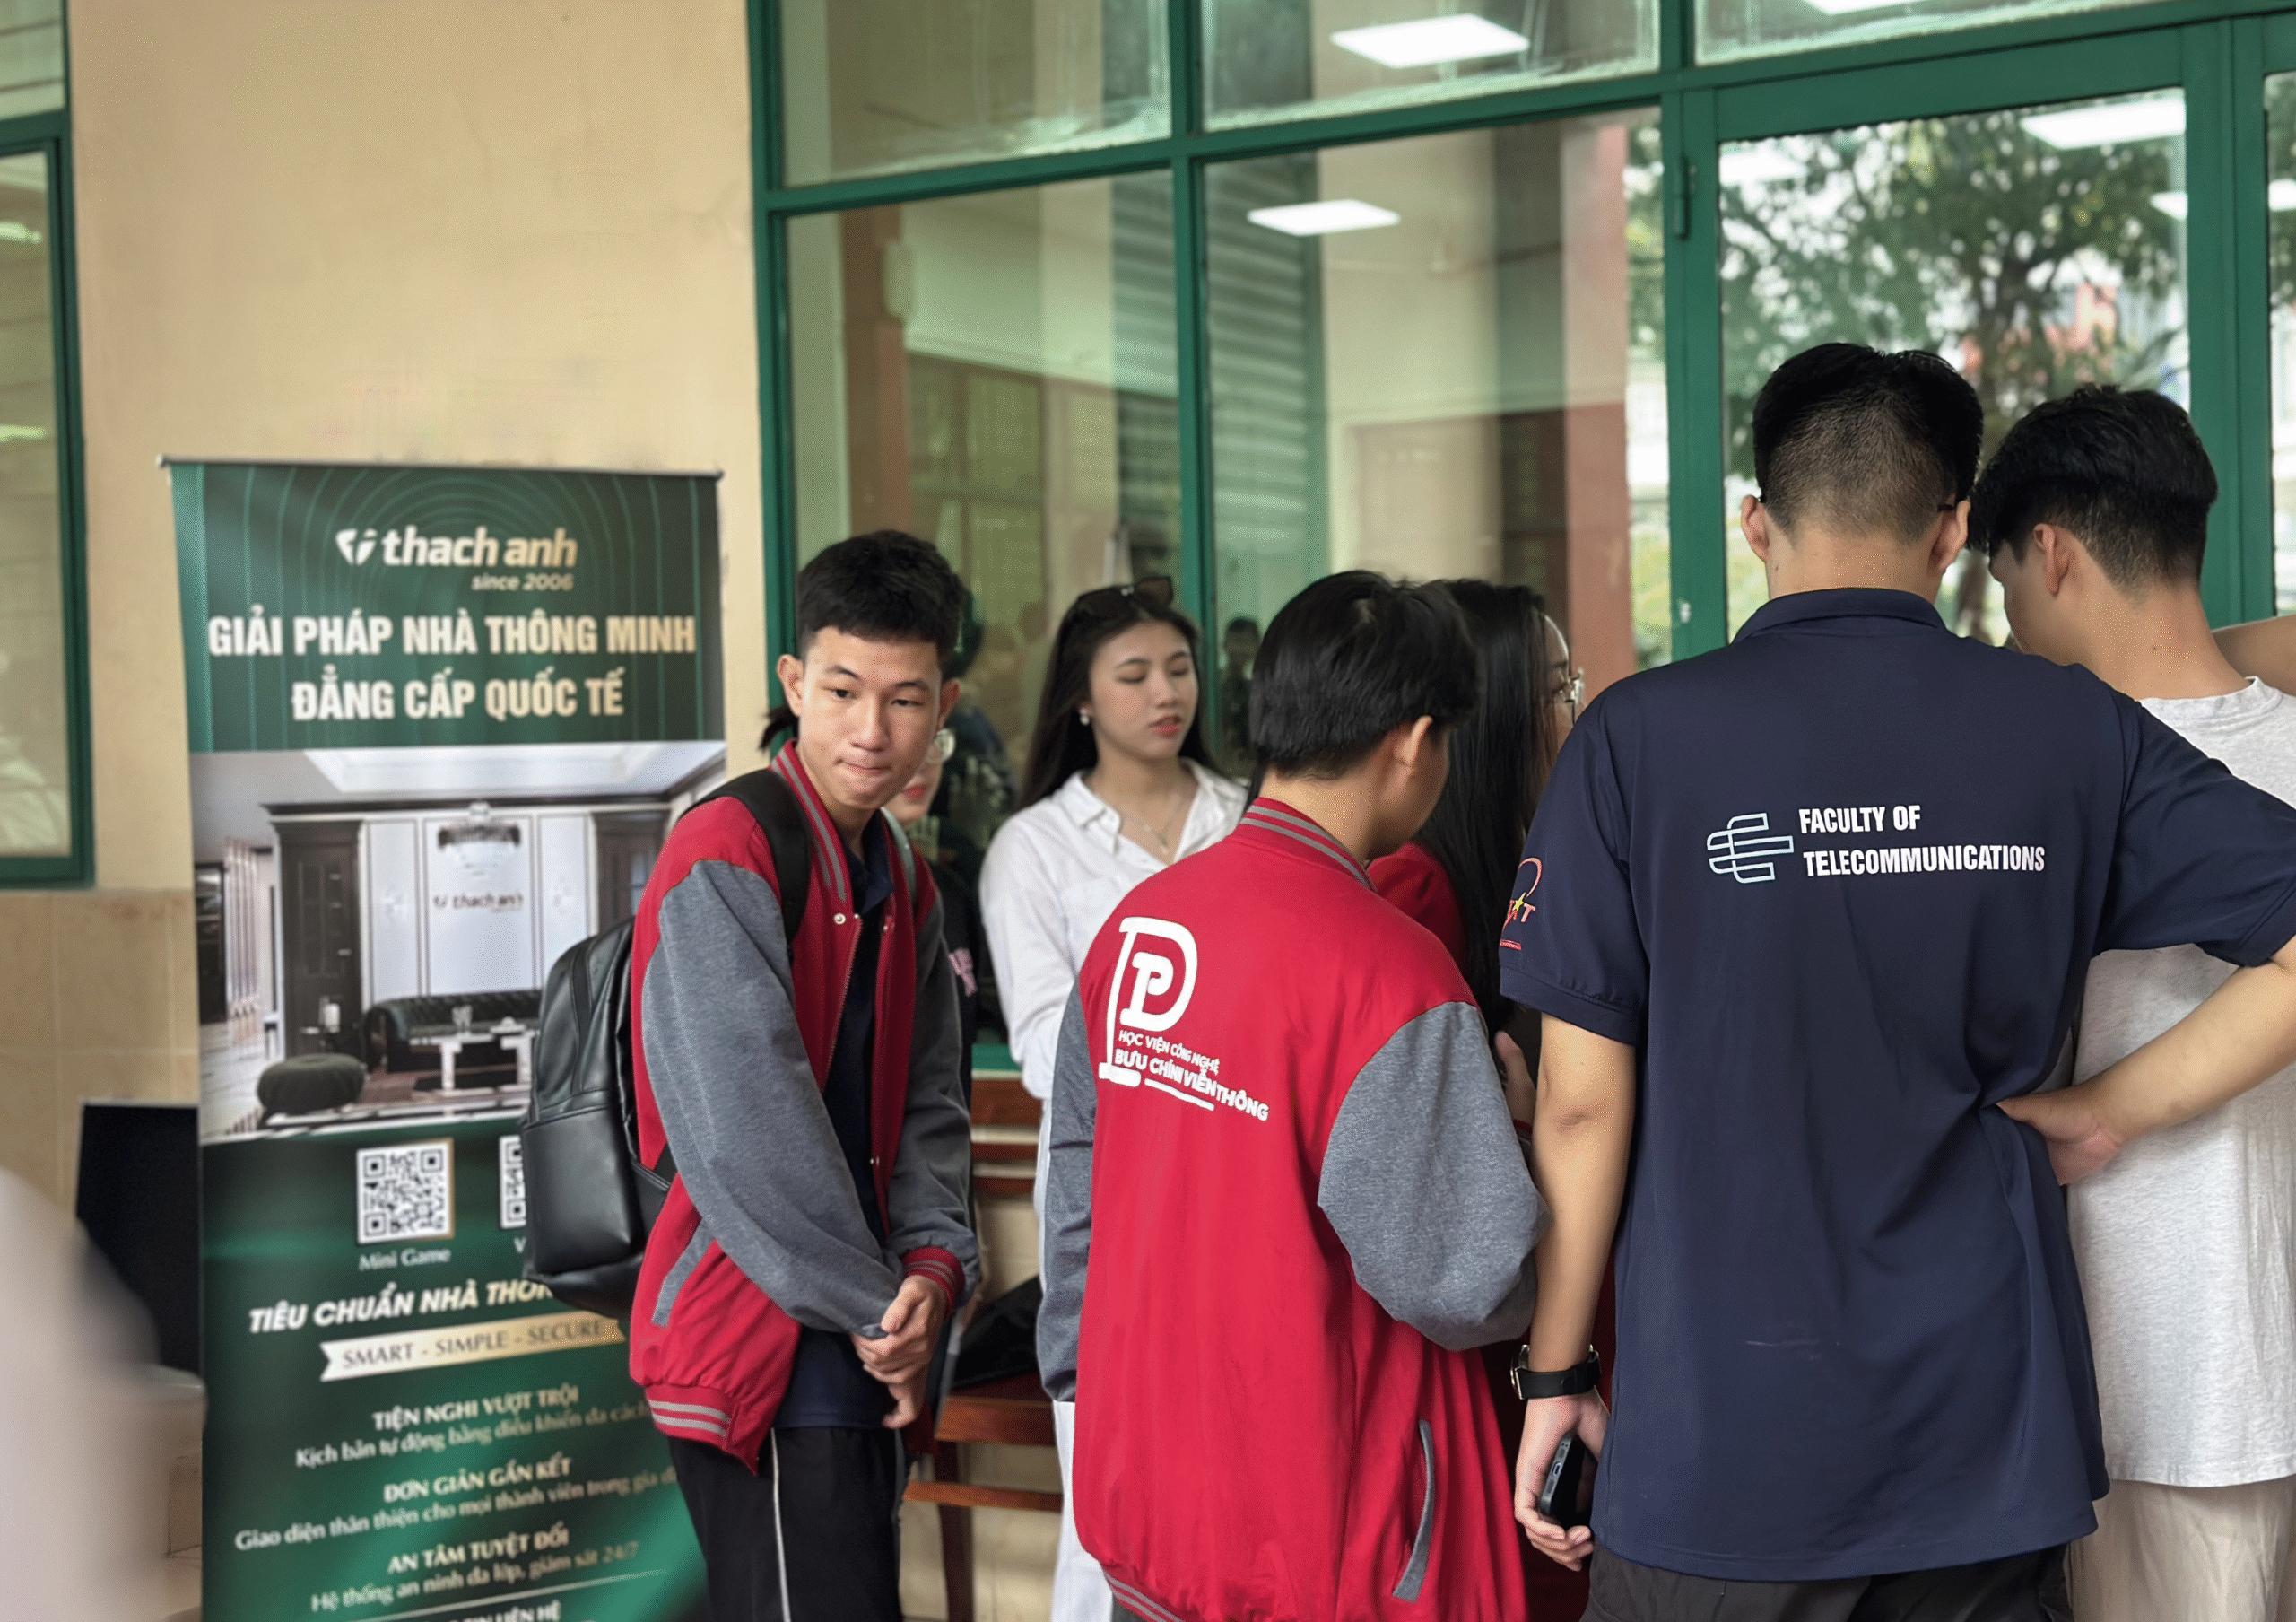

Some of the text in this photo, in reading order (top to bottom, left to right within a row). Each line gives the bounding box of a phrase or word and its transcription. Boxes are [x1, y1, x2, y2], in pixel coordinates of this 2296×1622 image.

[381, 525, 578, 567] thach anh
[472, 573, 574, 591] since 2006
[207, 604, 696, 656] GIẢI PHÁP NHÀ THÔNG MINH
[291, 663, 626, 721] ĐẲNG CẤP QUỐC TẾ
[1798, 805, 1921, 834] FACULTY OF
[1803, 844, 2046, 877] TELECOMMUNICATIONS
[1118, 1030, 1221, 1077] HỌC VIỆN CÔNG NGHỆ
[1114, 1048, 1149, 1071] BƯU
[1215, 1084, 1270, 1122] THÔNG
[358, 1247, 452, 1271] Mini Game
[249, 1300, 309, 1334] TIÊU
[313, 1281, 415, 1328] CHUẨN
[419, 1278, 479, 1314] NHÀ
[341, 1342, 415, 1371] SMART
[435, 1330, 507, 1358] SIMPLE
[526, 1320, 602, 1345] SECURE
[372, 1382, 579, 1433] TIỆN NGHI VƯỢT TRỘI
[296, 1443, 339, 1469] Kịch
[383, 1479, 430, 1503] ĐƠN
[433, 1468, 485, 1496] GIẢN
[536, 1451, 572, 1480] KẾT
[234, 1528, 282, 1551] Giao
[283, 1522, 326, 1544] diện
[329, 1514, 370, 1538] thân
[422, 1502, 457, 1522] cho
[387, 1521, 570, 1575] AN TÂM TUYỆT ĐỐI
[310, 1590, 340, 1613] Hệ
[396, 1582, 421, 1600] an
[422, 1571, 465, 1594] ninh
